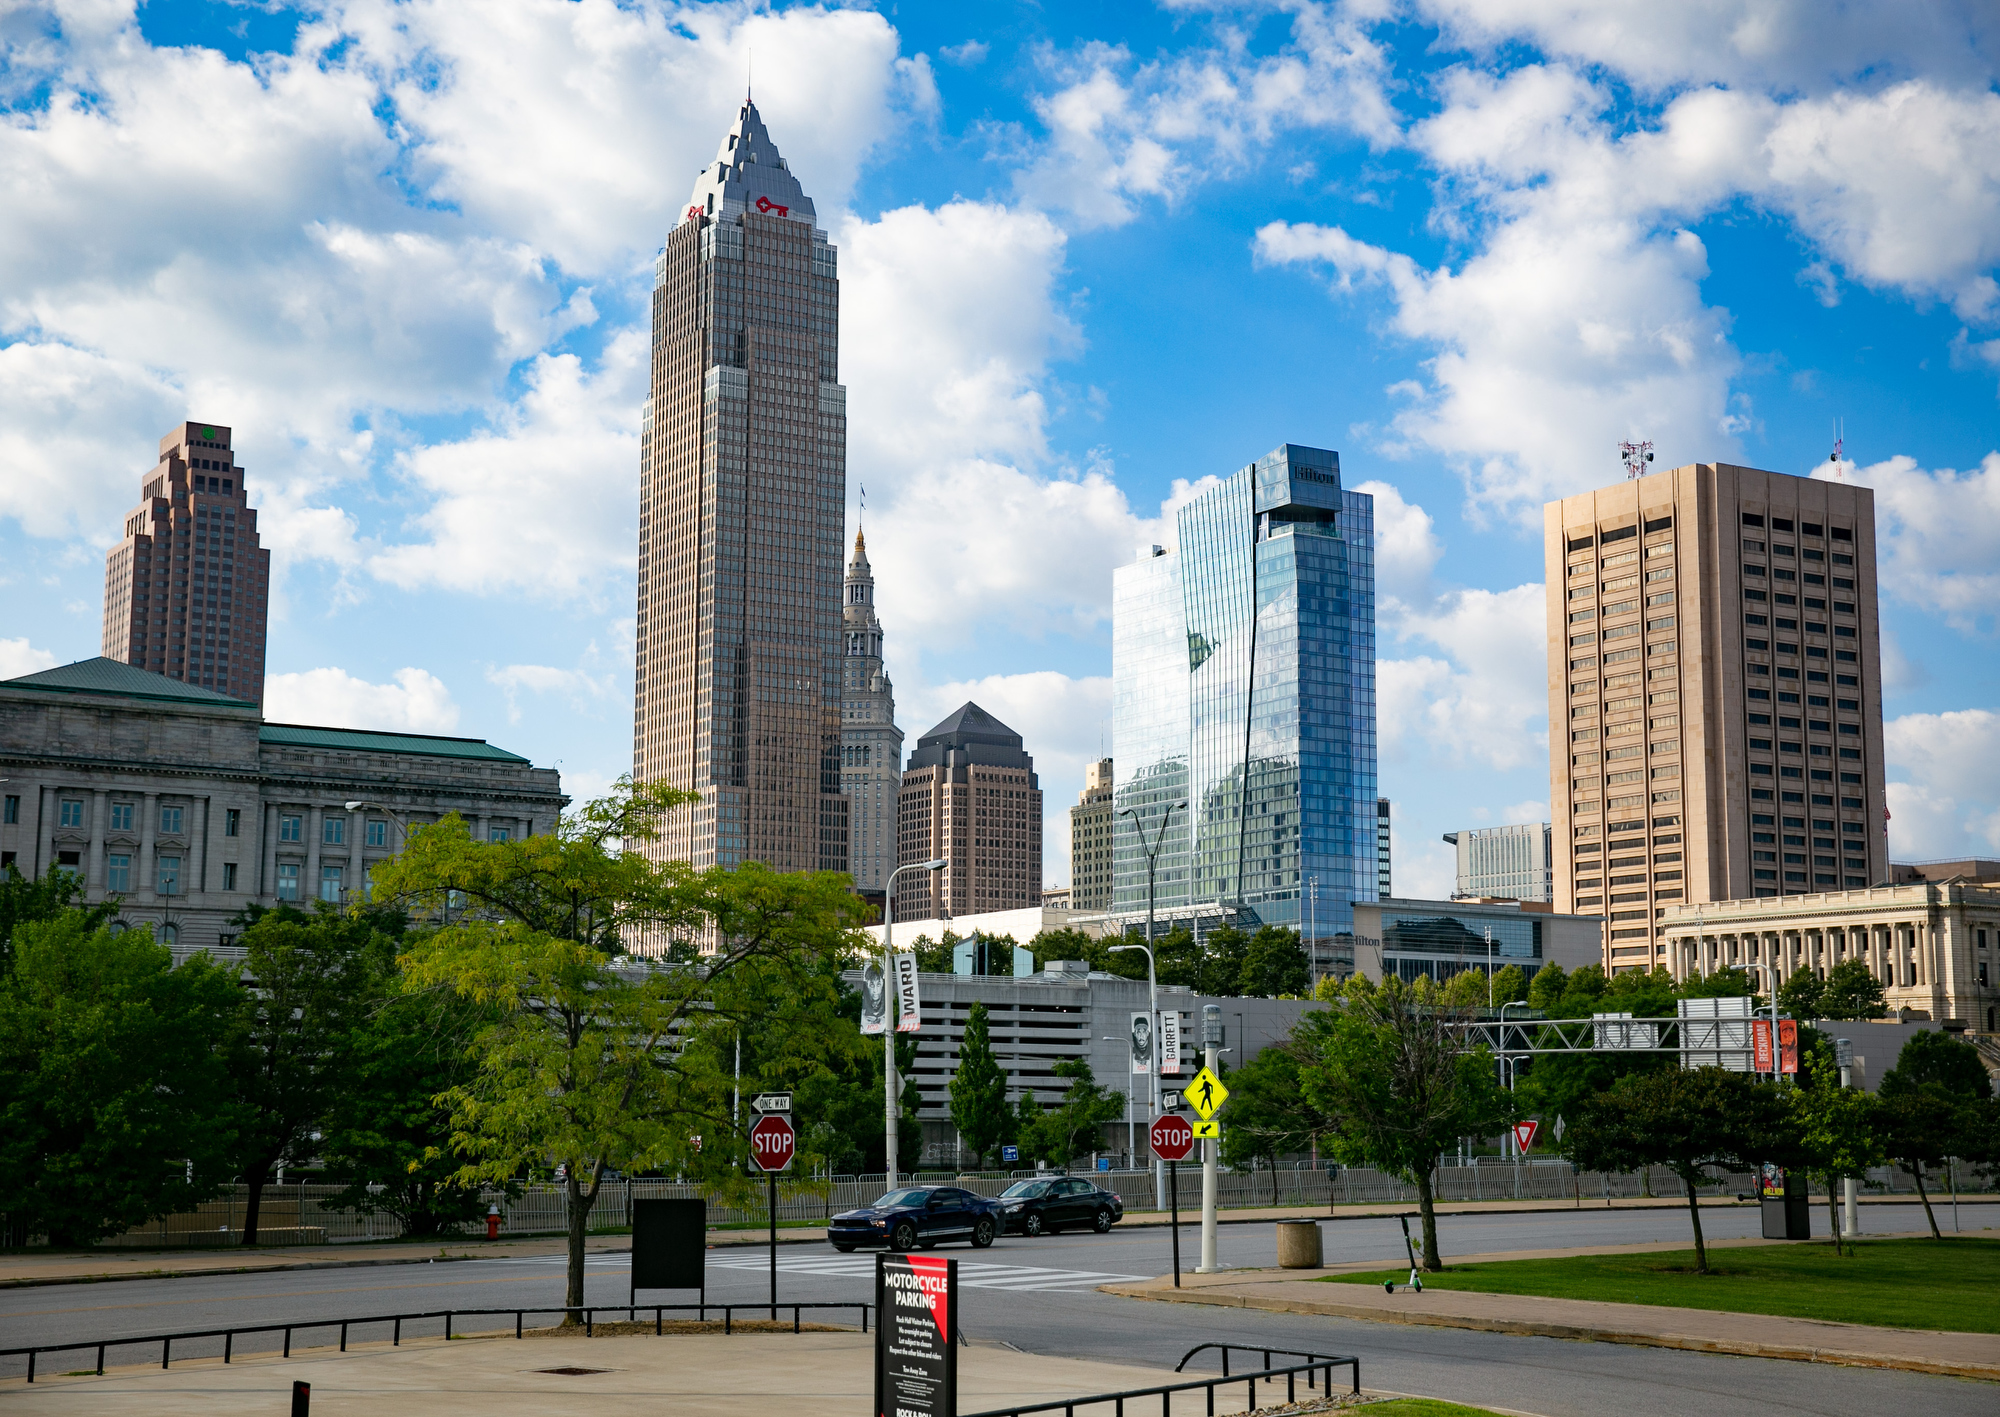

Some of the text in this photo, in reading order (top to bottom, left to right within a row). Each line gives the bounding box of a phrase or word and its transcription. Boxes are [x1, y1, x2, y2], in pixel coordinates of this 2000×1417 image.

[1294, 466, 1335, 485] Hilton
[900, 960, 915, 1015] WARD
[1164, 1016, 1176, 1060] GARRETT
[1756, 1024, 1769, 1062] BECKHAM
[760, 1098, 788, 1109] ONE WAY
[755, 1133, 792, 1153] STOP
[1153, 1129, 1191, 1146] STOP
[885, 1272, 947, 1294] MOTORCYCLE
[895, 1291, 936, 1310] PARKING
[922, 1318, 935, 1329] Parking
